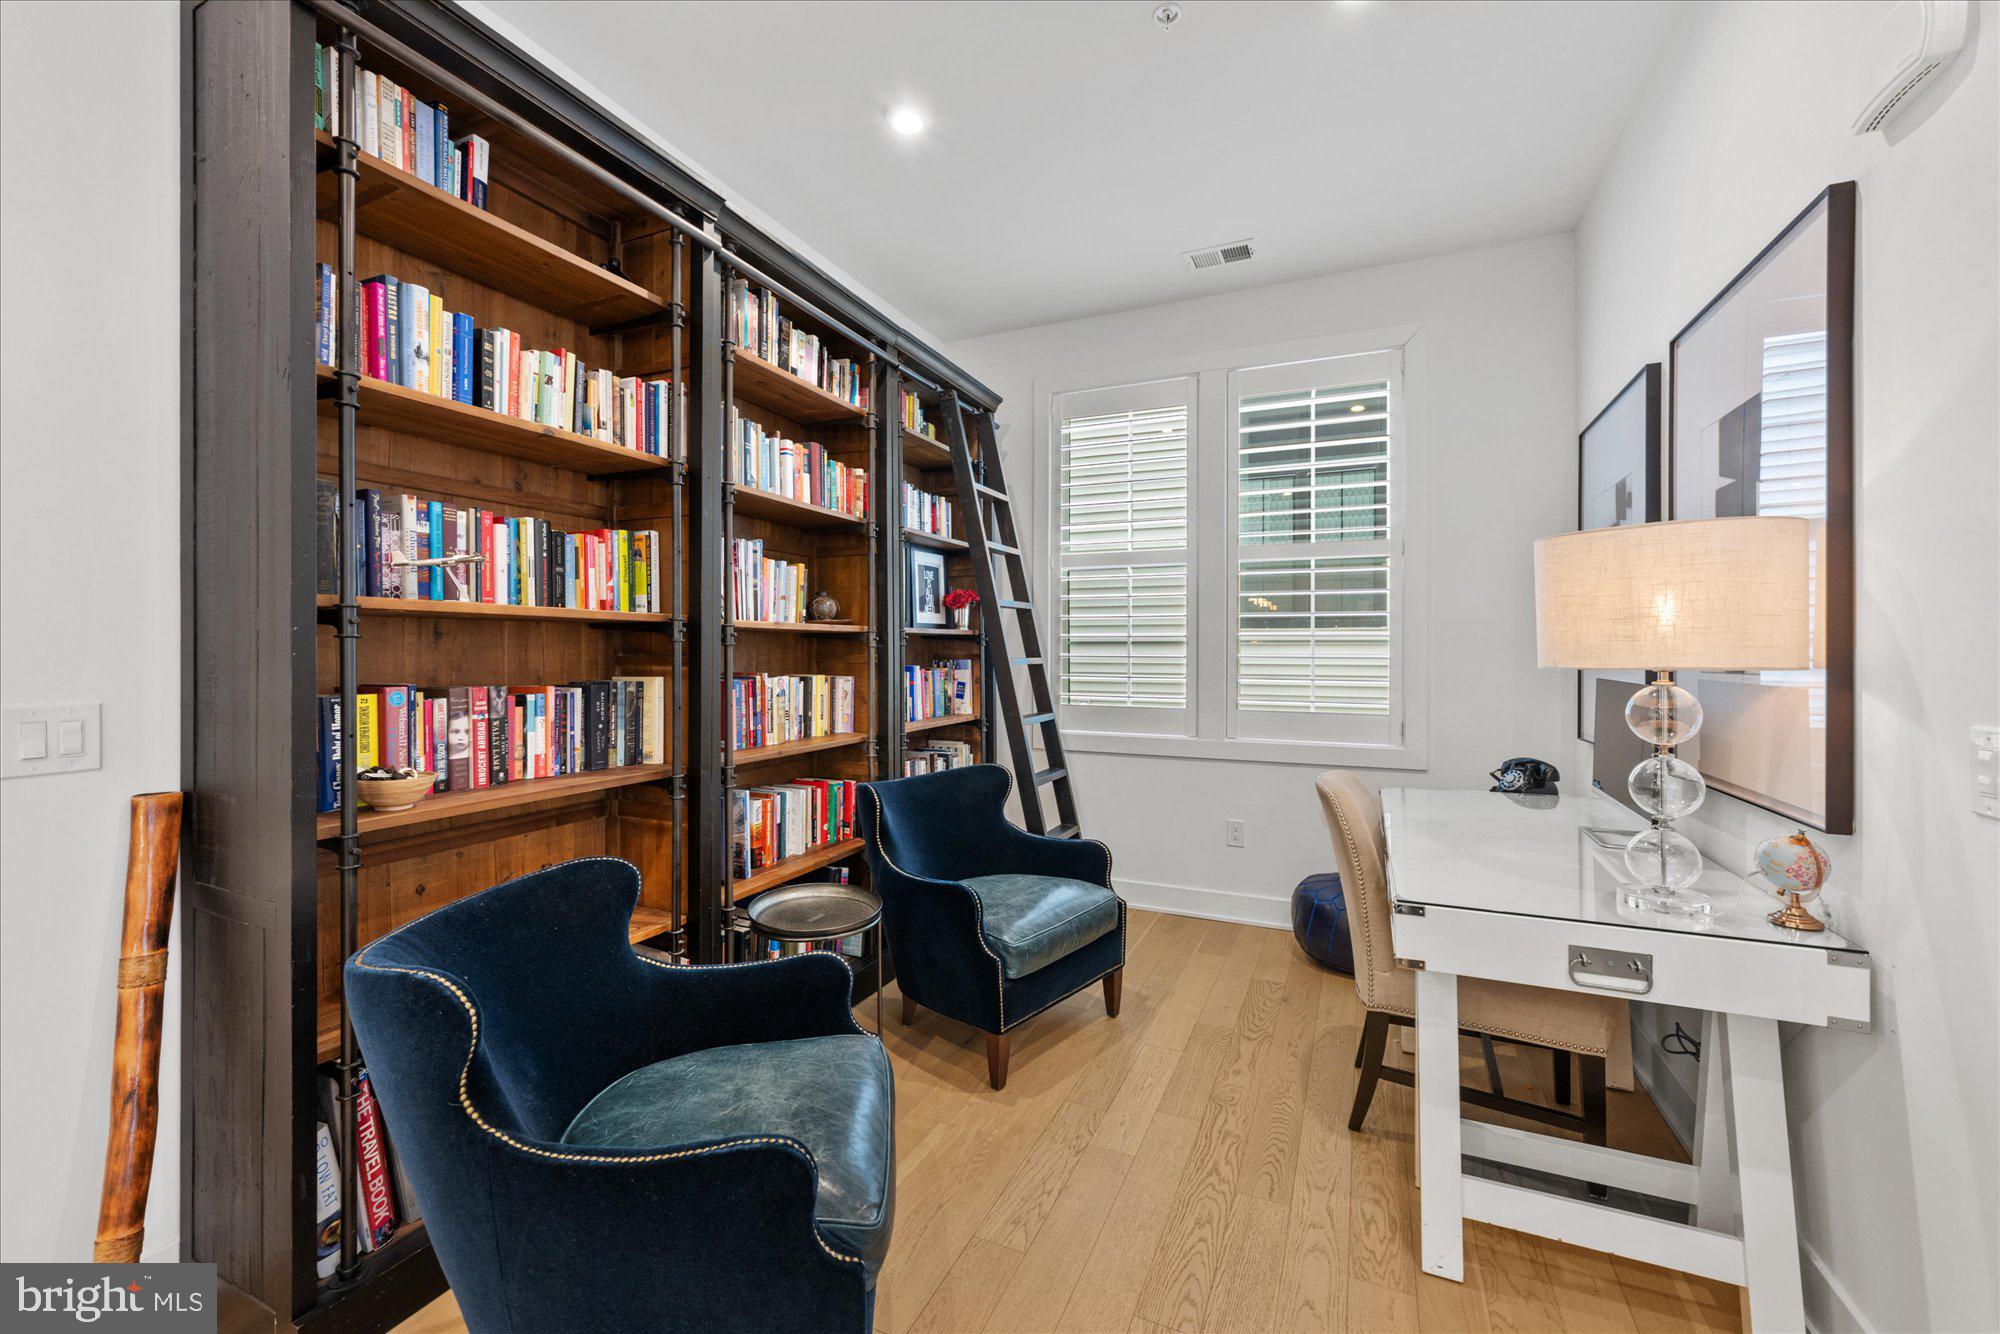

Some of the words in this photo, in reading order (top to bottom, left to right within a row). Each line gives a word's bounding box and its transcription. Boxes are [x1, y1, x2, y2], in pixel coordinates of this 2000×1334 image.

[387, 285, 397, 320] MAESTRO
[477, 722, 486, 749] ABROAD
[492, 720, 500, 747] WALLY
[437, 744, 445, 758] CROSS
[478, 751, 487, 785] INNOCENT
[357, 1084, 372, 1122] THE
[359, 1118, 380, 1180] TRAVEL
[322, 1181, 338, 1208] FAT
[370, 1174, 391, 1225] BOOK
